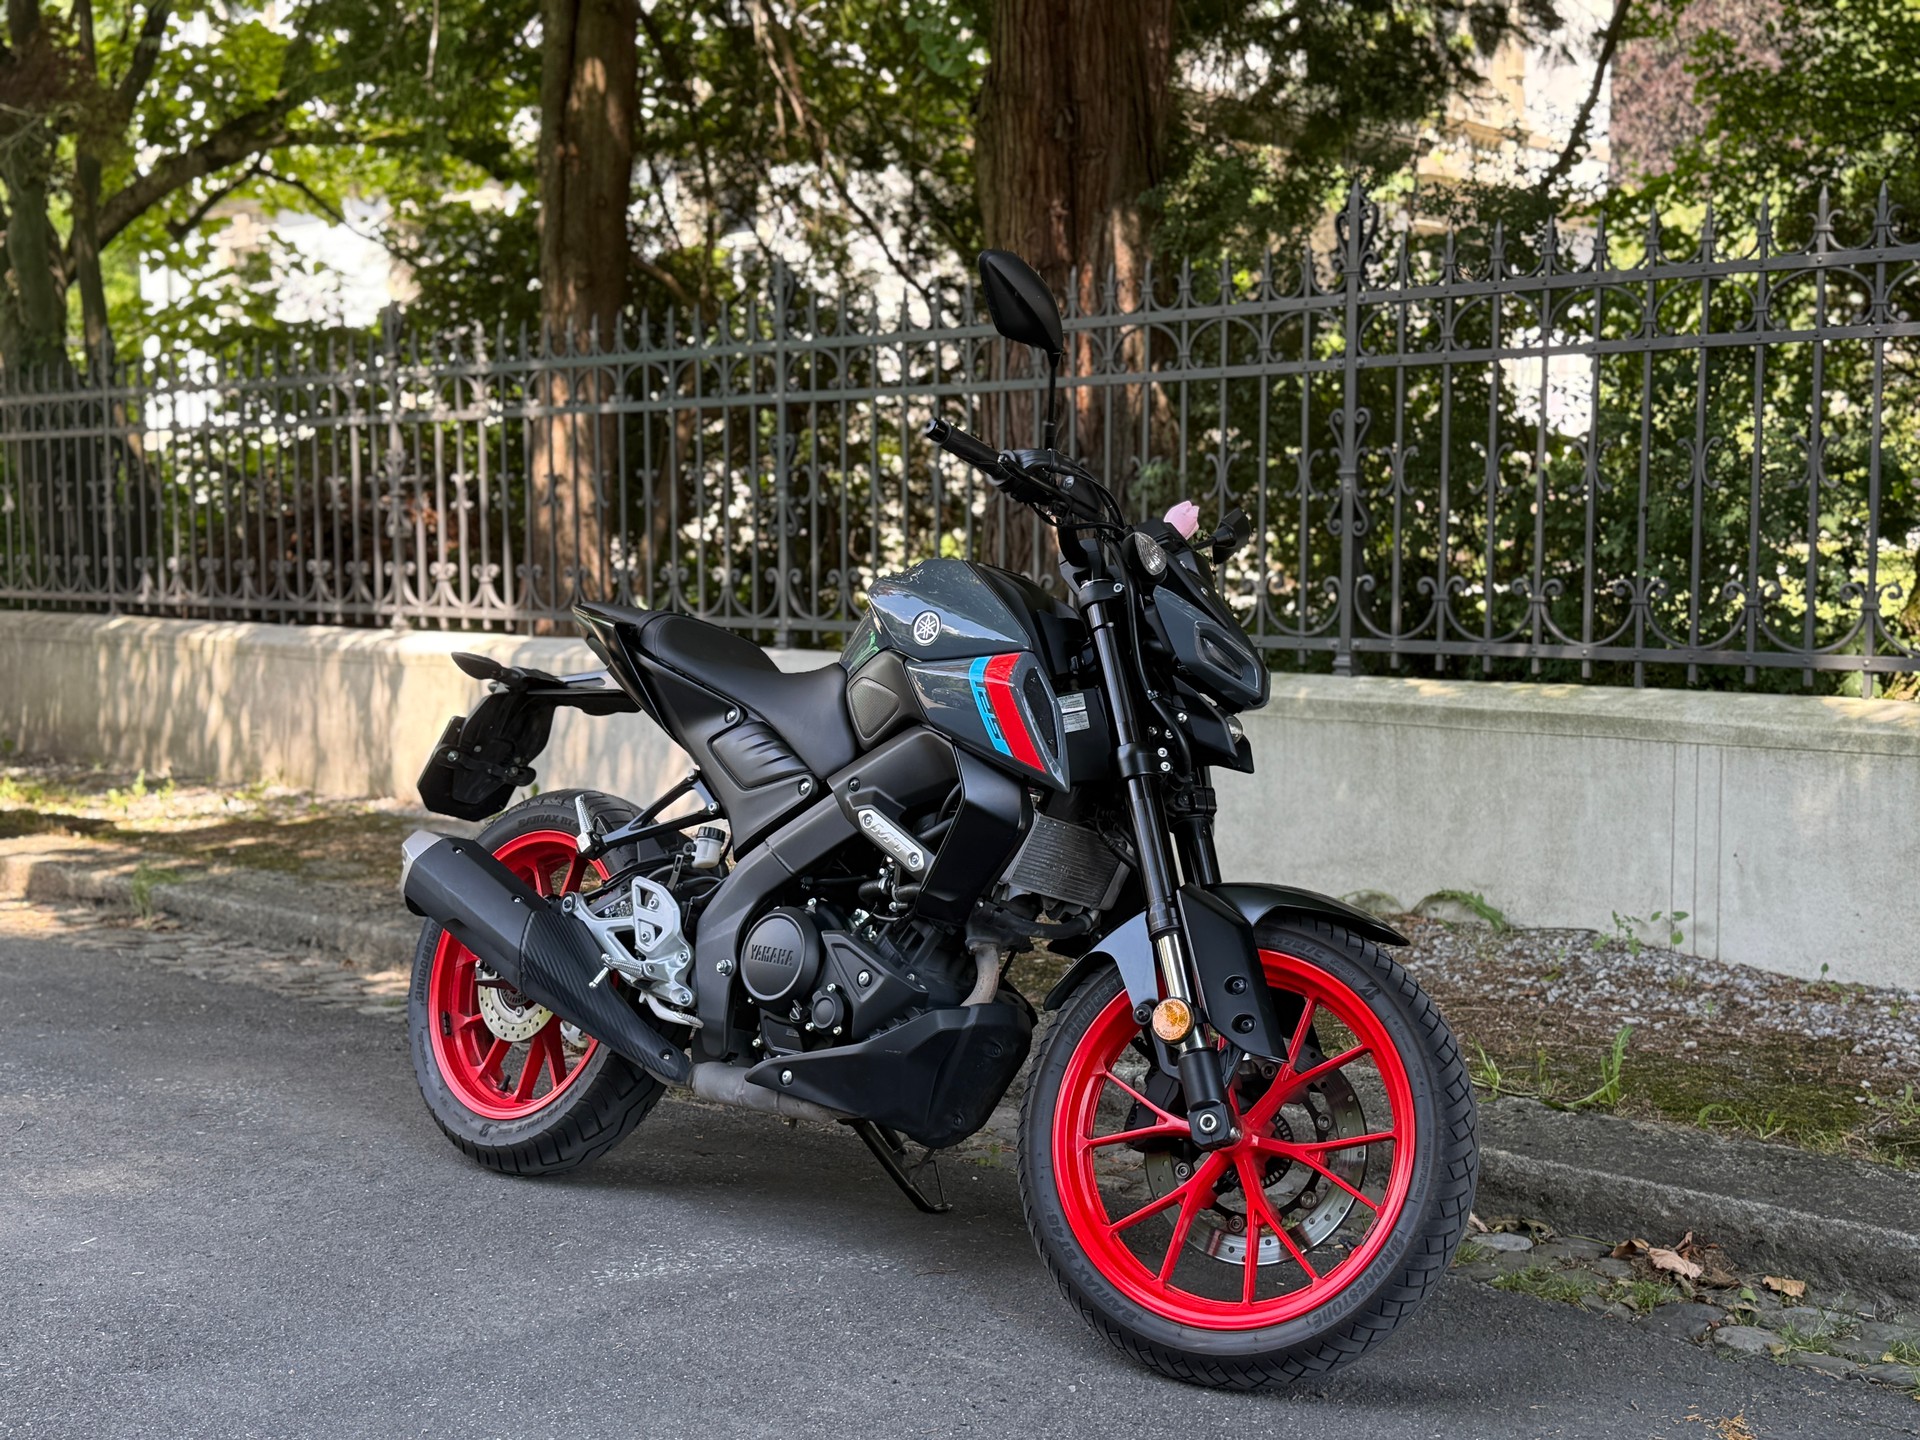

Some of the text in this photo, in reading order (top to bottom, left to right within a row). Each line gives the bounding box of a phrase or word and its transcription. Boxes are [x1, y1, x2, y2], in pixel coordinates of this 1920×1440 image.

[870, 822, 912, 853] MT
[414, 922, 440, 1003] BRIDGESTON
[750, 943, 794, 967] YAMAHA
[1064, 974, 1125, 1043] BRIDGEST
[1313, 1232, 1406, 1329] BRIDGESTONE
